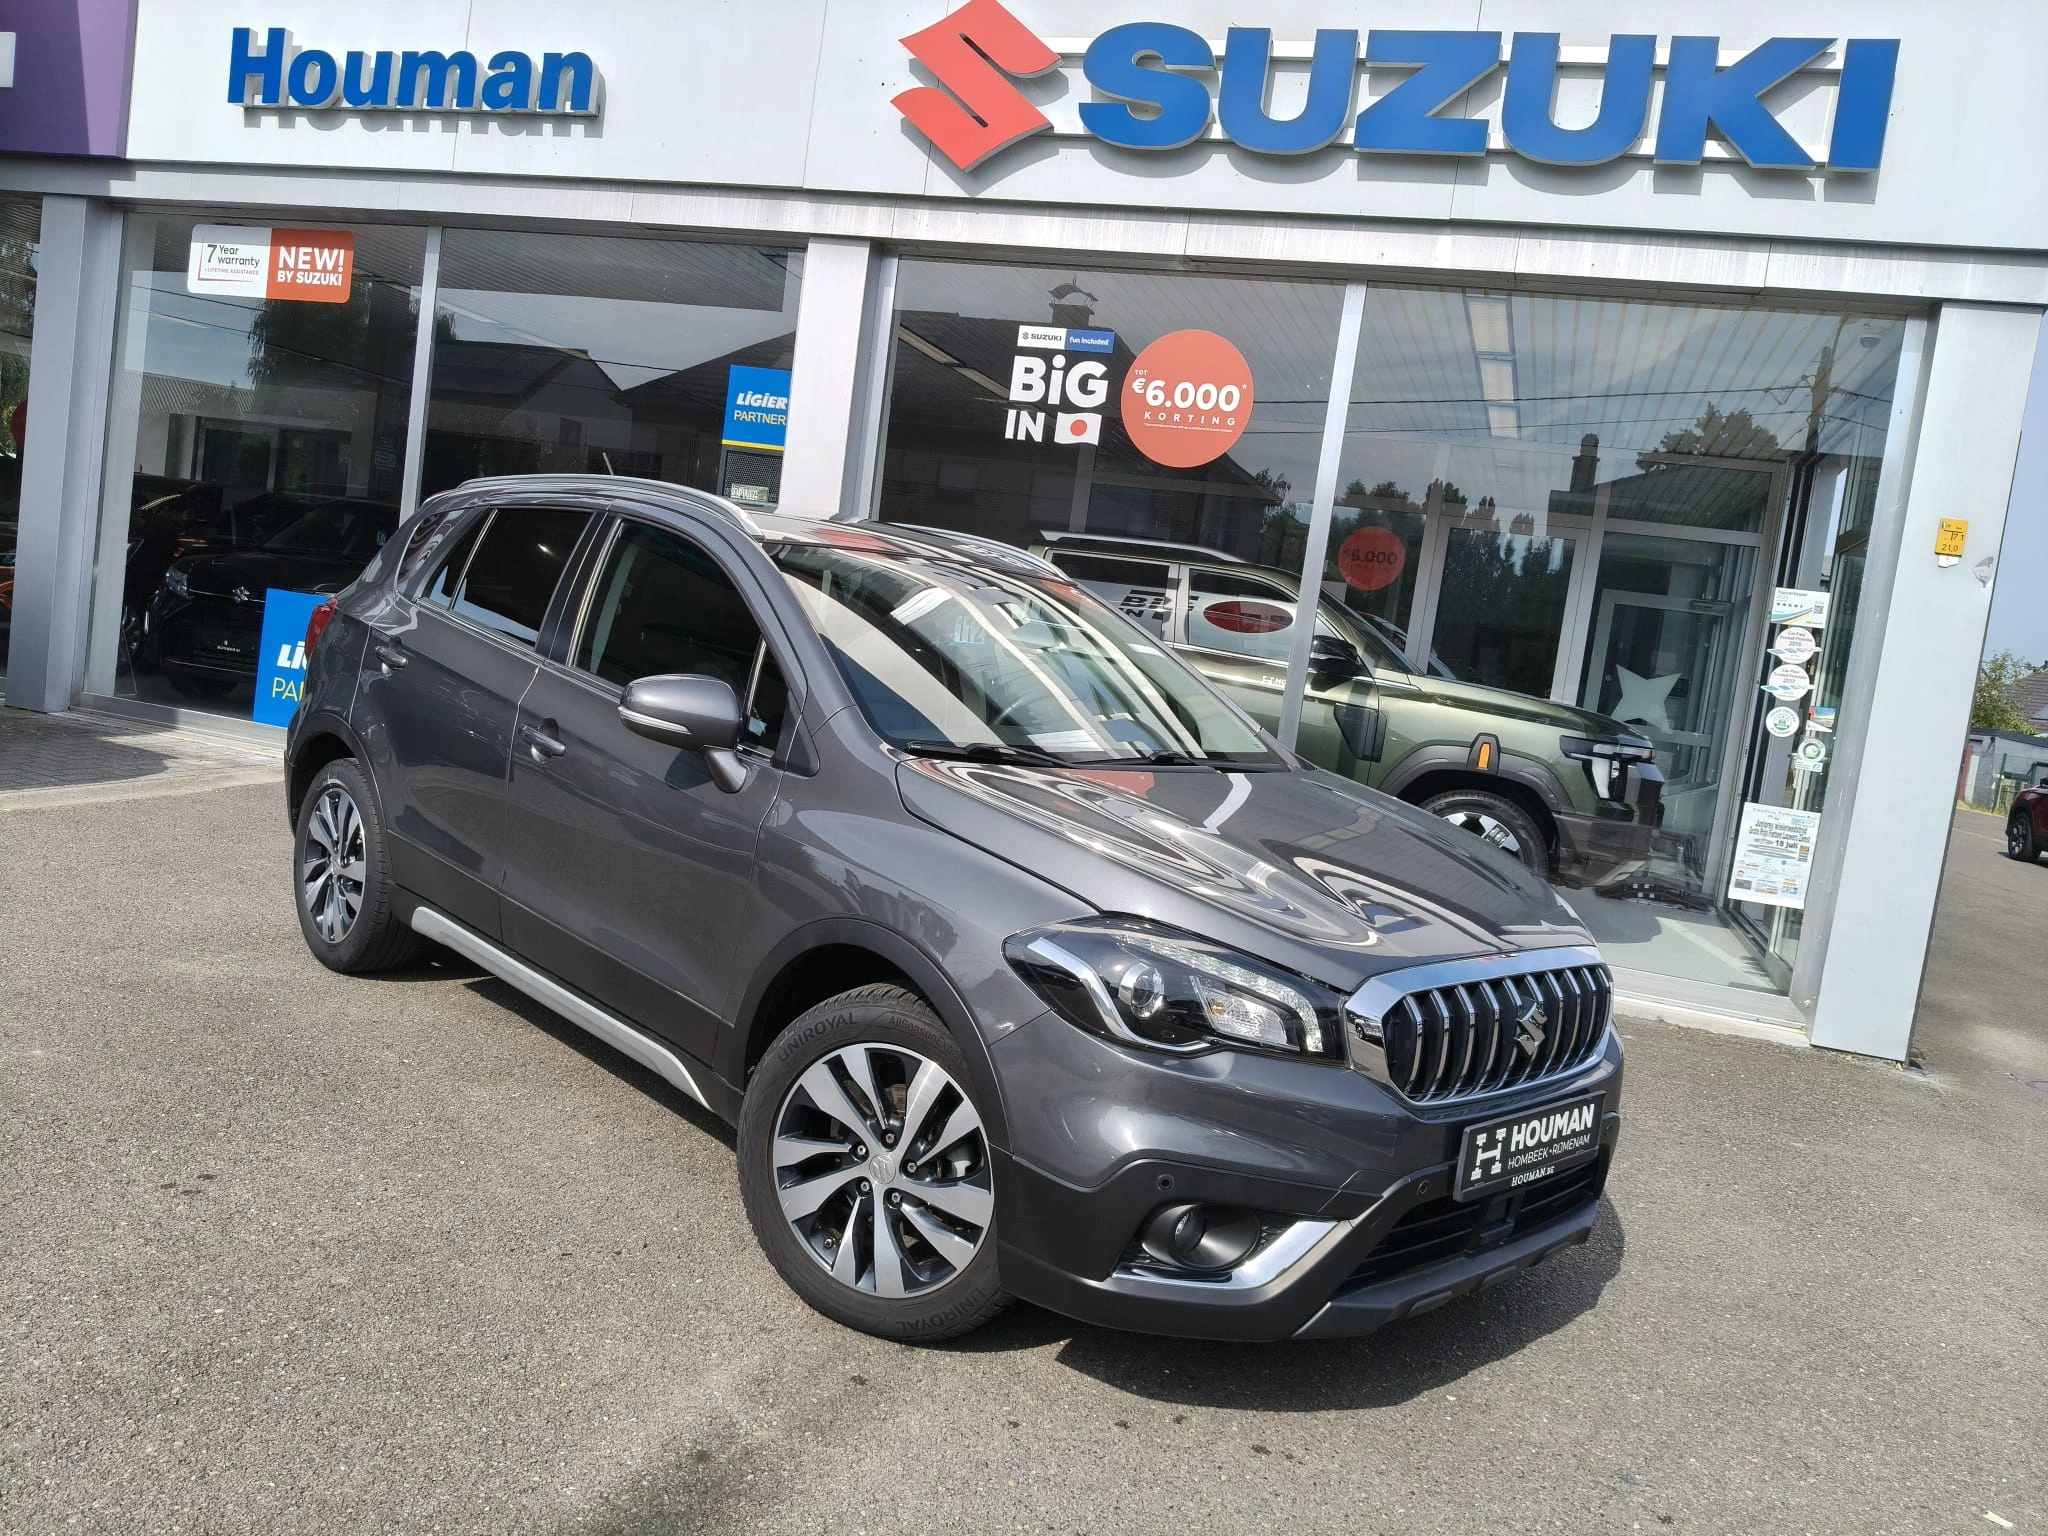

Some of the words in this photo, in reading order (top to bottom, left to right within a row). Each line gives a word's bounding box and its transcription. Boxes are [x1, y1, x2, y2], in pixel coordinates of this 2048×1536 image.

[227, 27, 599, 113] Houman
[1079, 22, 1901, 173] SUZUKI
[207, 244, 218, 263] 7
[219, 245, 240, 255] Year
[218, 256, 260, 268] warranty
[278, 246, 345, 273] NEW!
[277, 270, 294, 283] BY
[1030, 333, 1062, 342] SUZUKI
[734, 409, 787, 426] PARTNER
[1004, 409, 1046, 442] IN
[777, 1012, 860, 1063] UNIROYAL
[1510, 1103, 1595, 1152] HOUMAN
[1511, 1165, 1556, 1187] HOUMAN.BE
[895, 1288, 986, 1333] UNIROYAL
